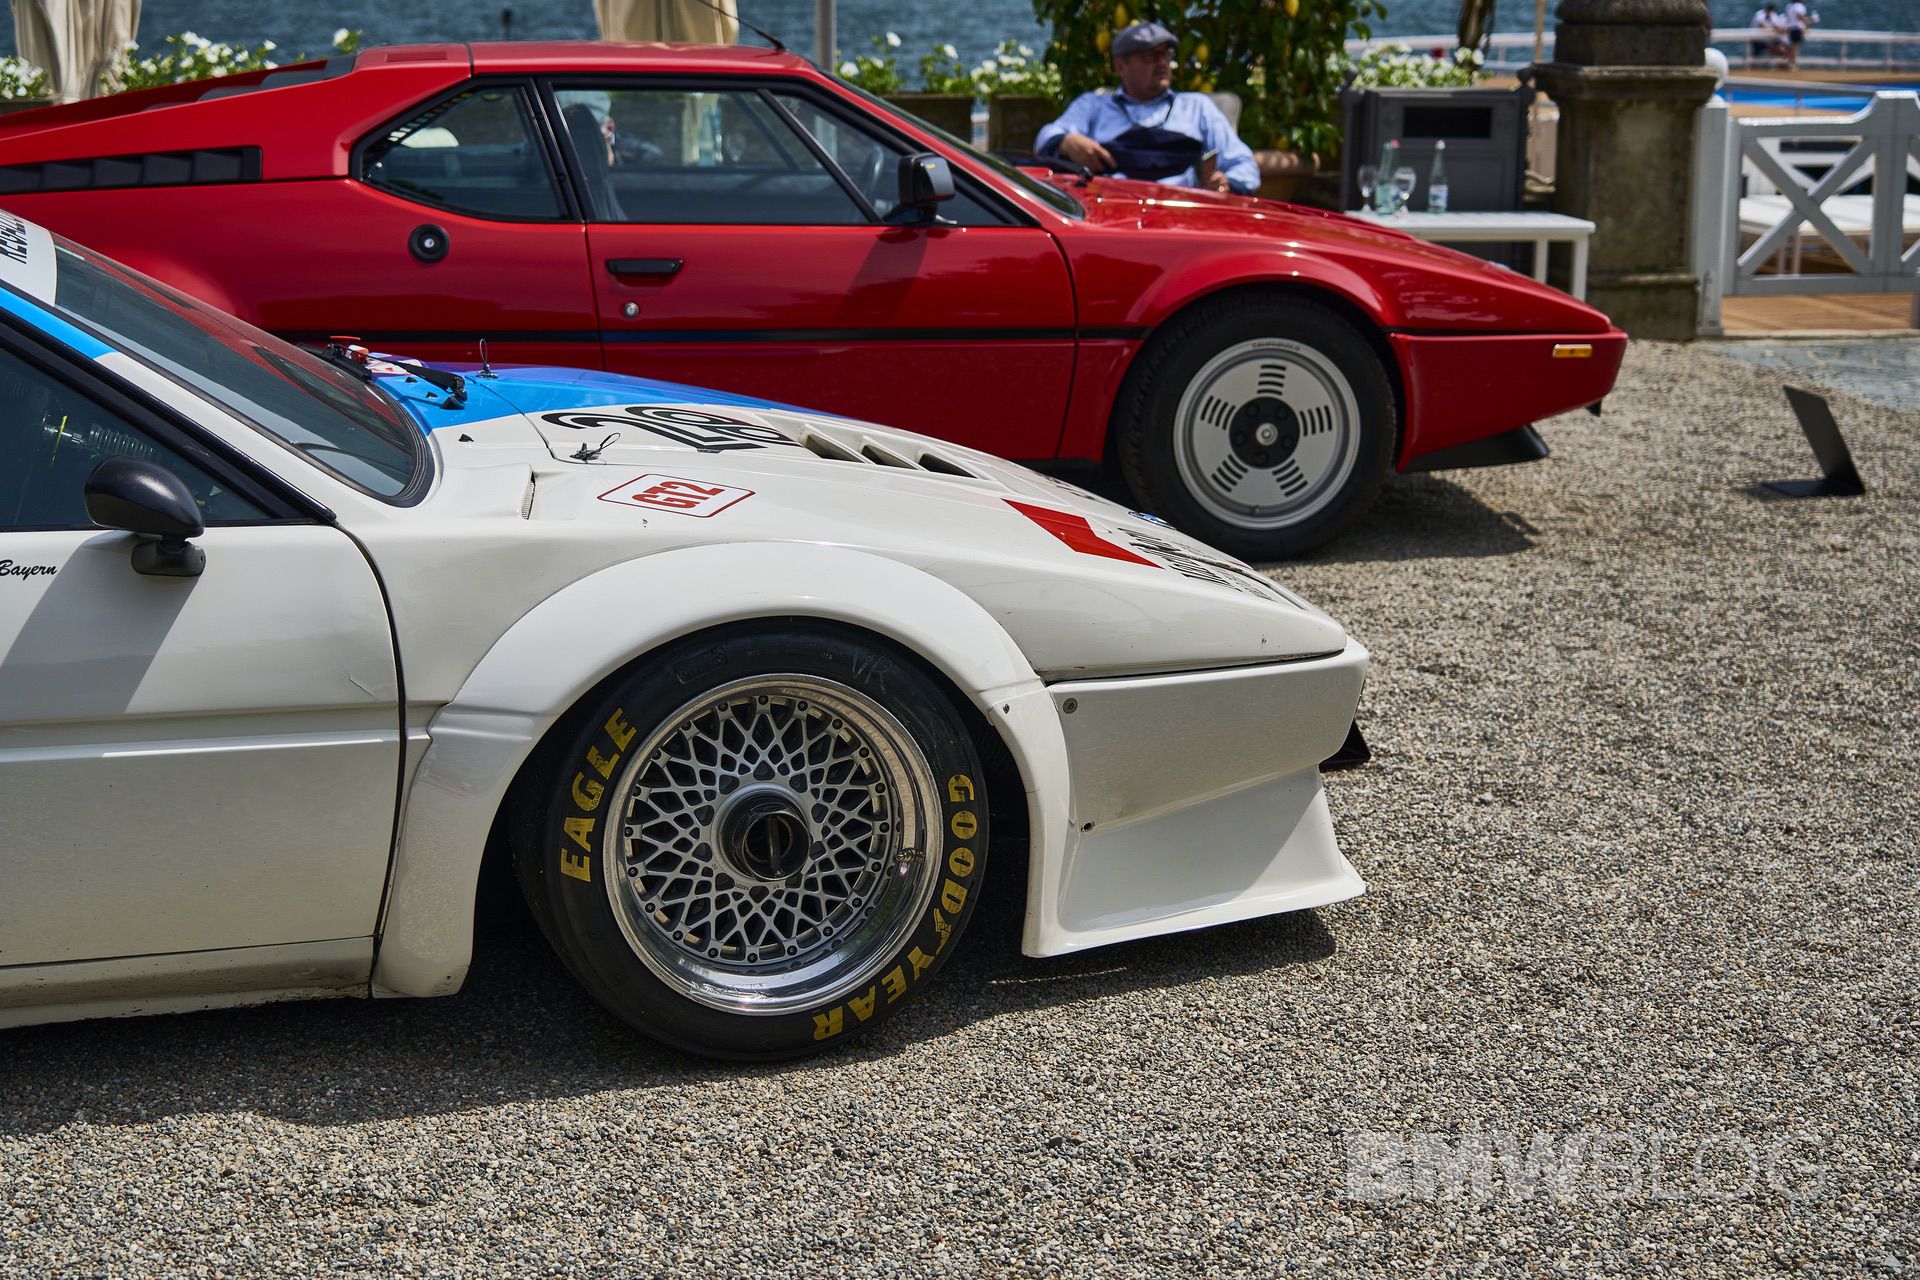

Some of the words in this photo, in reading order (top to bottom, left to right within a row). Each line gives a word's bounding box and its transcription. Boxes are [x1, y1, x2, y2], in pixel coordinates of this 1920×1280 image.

[541, 406, 804, 451] 28
[632, 481, 726, 509] GT2
[0, 559, 58, 580] Bayern
[560, 708, 637, 882] EAGLE
[812, 774, 978, 1041] GOODYEAR
